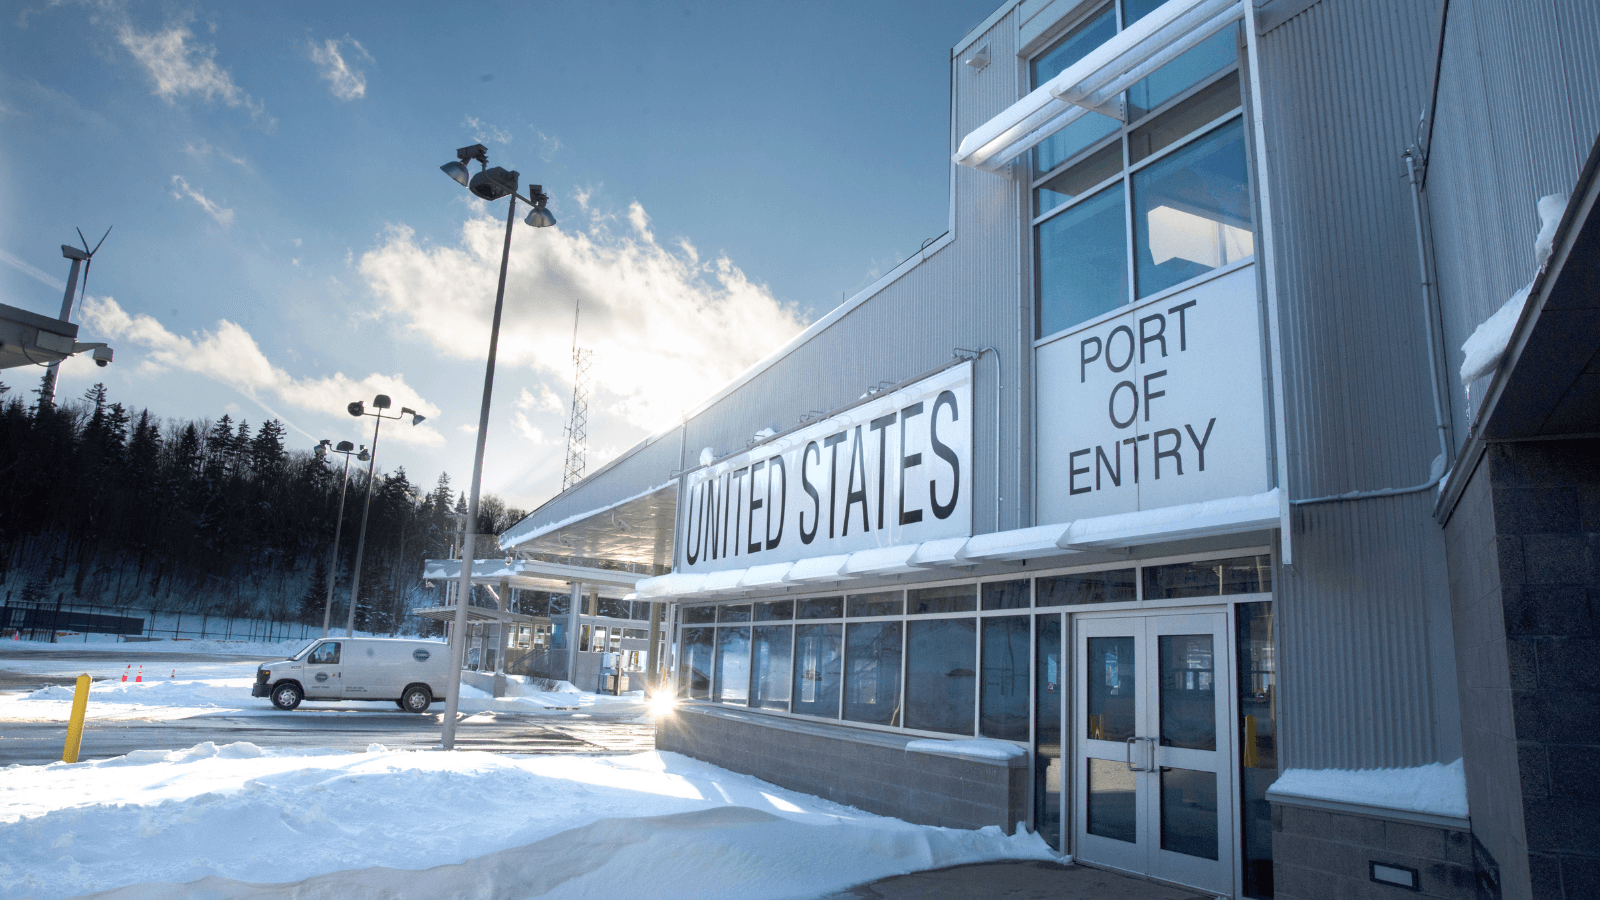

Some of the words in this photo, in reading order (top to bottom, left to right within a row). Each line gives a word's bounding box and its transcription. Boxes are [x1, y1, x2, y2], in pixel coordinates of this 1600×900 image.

[1081, 299, 1197, 383] PORT
[1109, 369, 1167, 429] OF
[686, 454, 786, 566] UNITED
[799, 389, 960, 545] STATES
[1069, 417, 1217, 496] ENTRY
